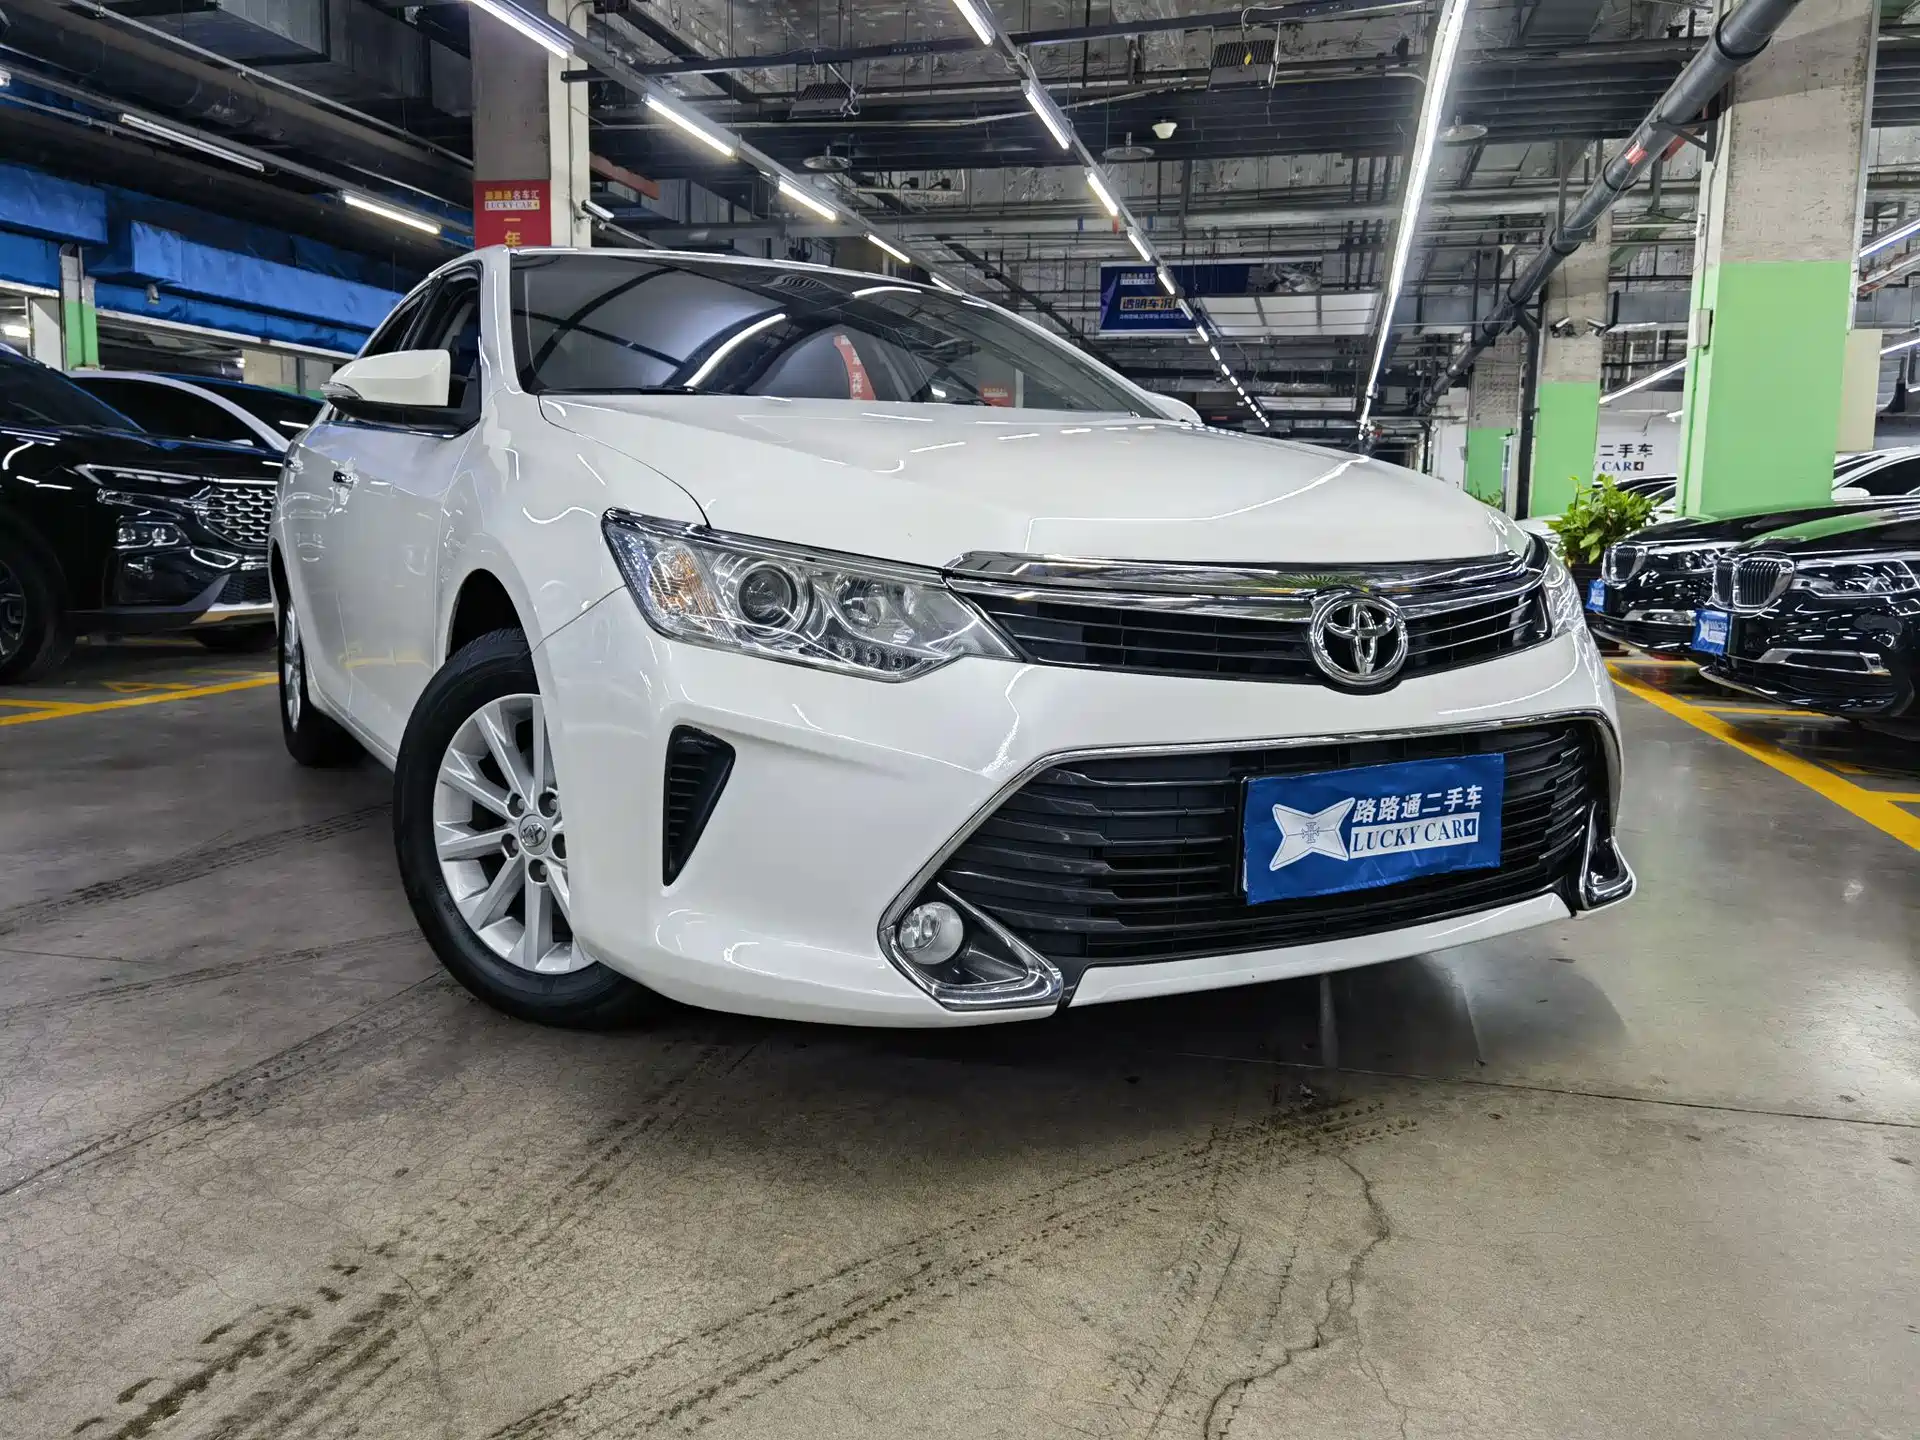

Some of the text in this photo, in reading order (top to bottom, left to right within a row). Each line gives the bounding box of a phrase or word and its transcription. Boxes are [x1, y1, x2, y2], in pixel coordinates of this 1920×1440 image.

[486, 201, 514, 209] LUCKY
[1599, 443, 1654, 458] 二手车
[1601, 461, 1632, 471] CAR
[1352, 785, 1482, 823] 路路通二手车
[1353, 819, 1463, 852] LUCKY CAR
